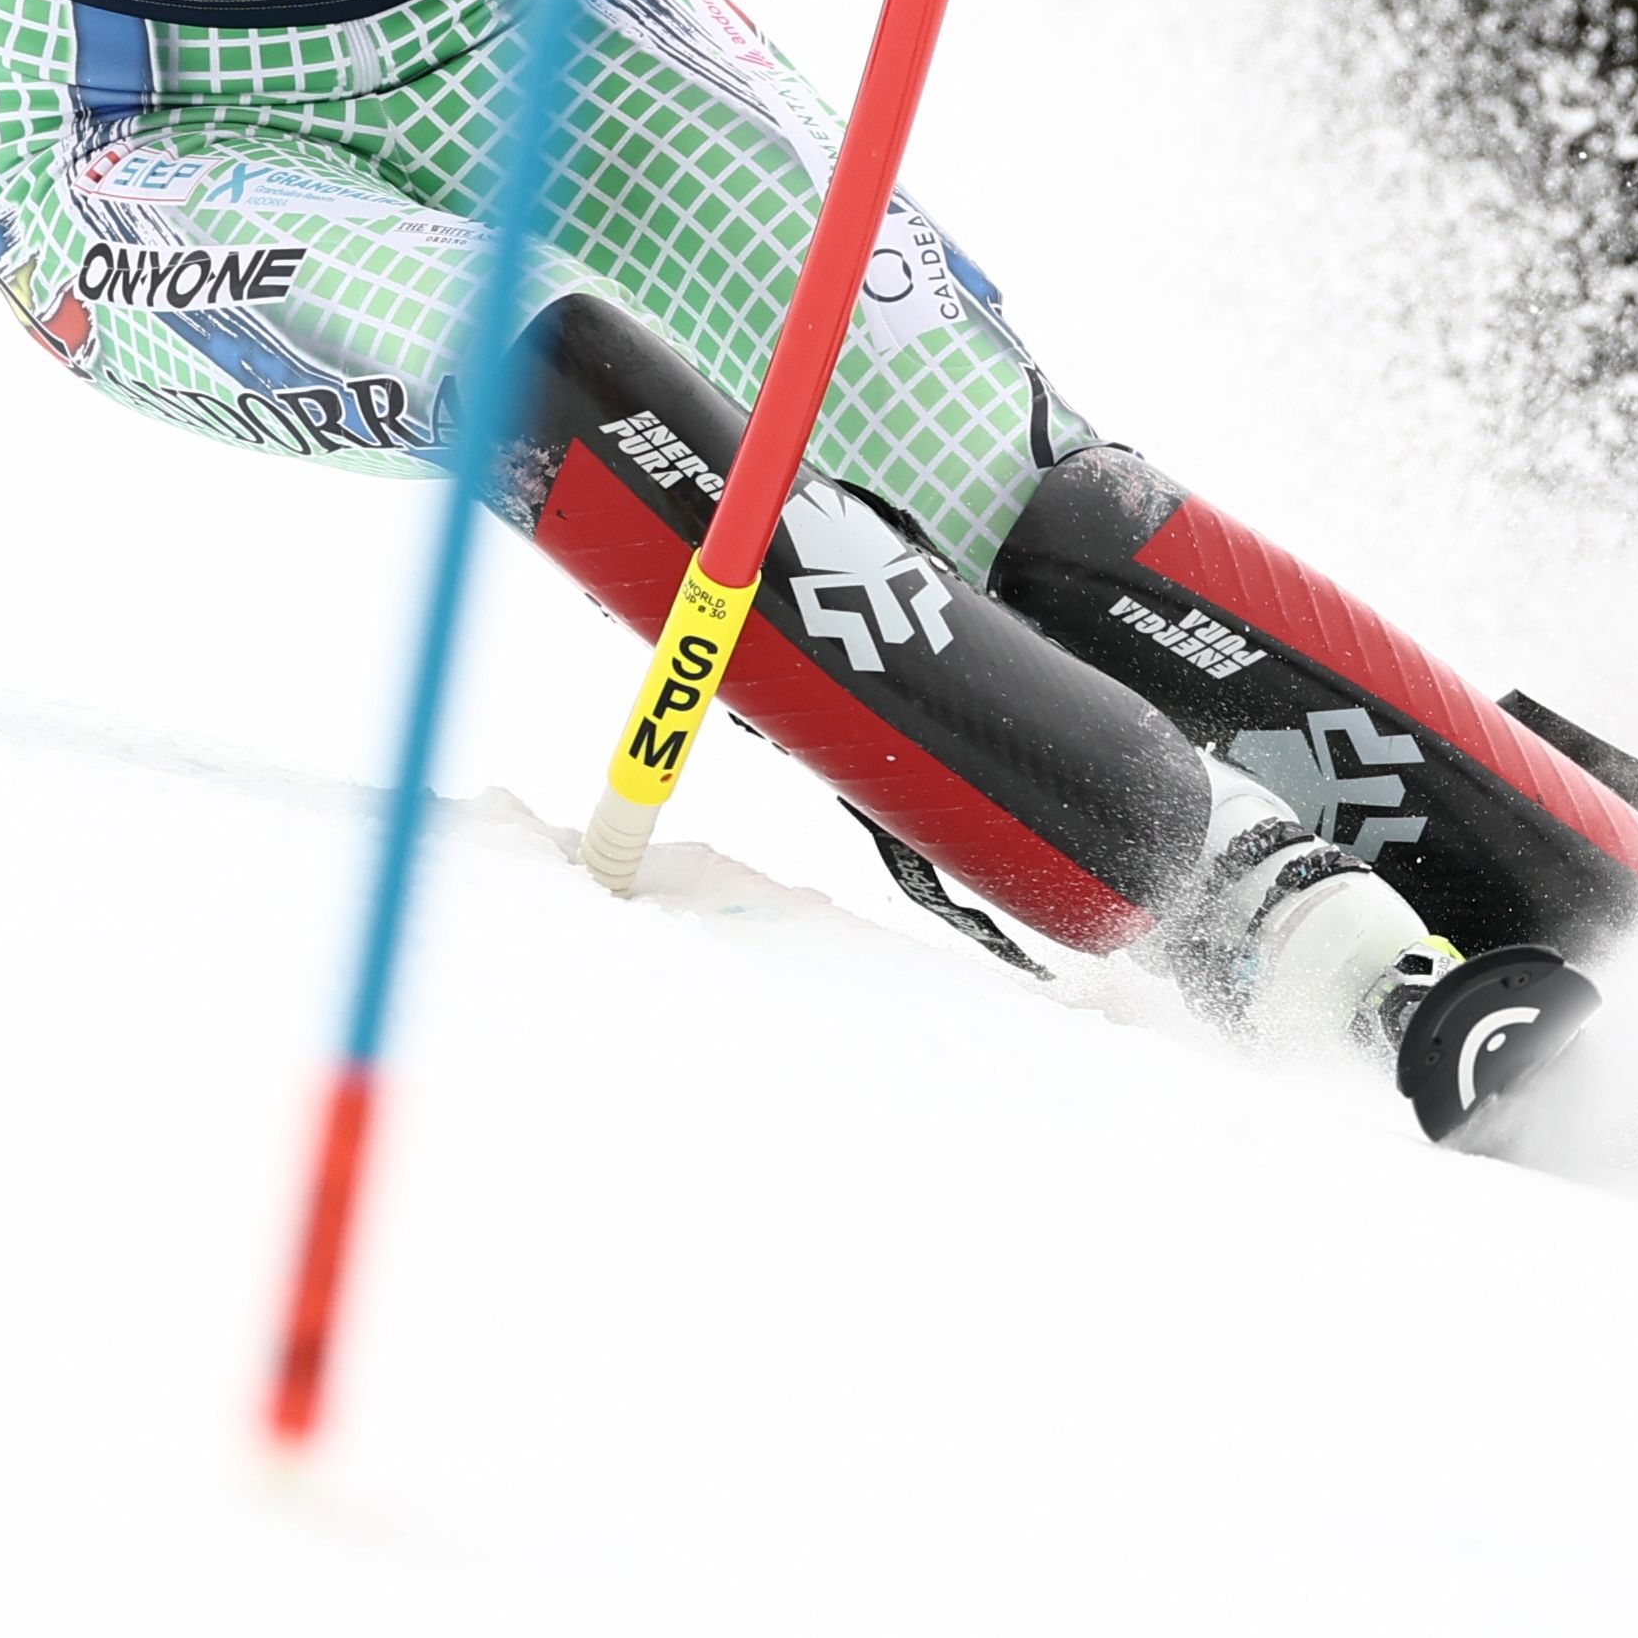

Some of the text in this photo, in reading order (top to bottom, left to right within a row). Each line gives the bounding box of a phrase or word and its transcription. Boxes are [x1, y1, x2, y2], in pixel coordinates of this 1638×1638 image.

[398, 221, 424, 233] THE
[425, 235, 467, 246] ORDINO
[907, 215, 960, 319] CALDEA
[598, 419, 685, 490] PURA
[687, 576, 726, 609] WORLD
[708, 608, 727, 620] 30
[1108, 595, 1243, 680] ENERGIA
[1178, 608, 1268, 667] PURA
[628, 635, 719, 770] SPM
